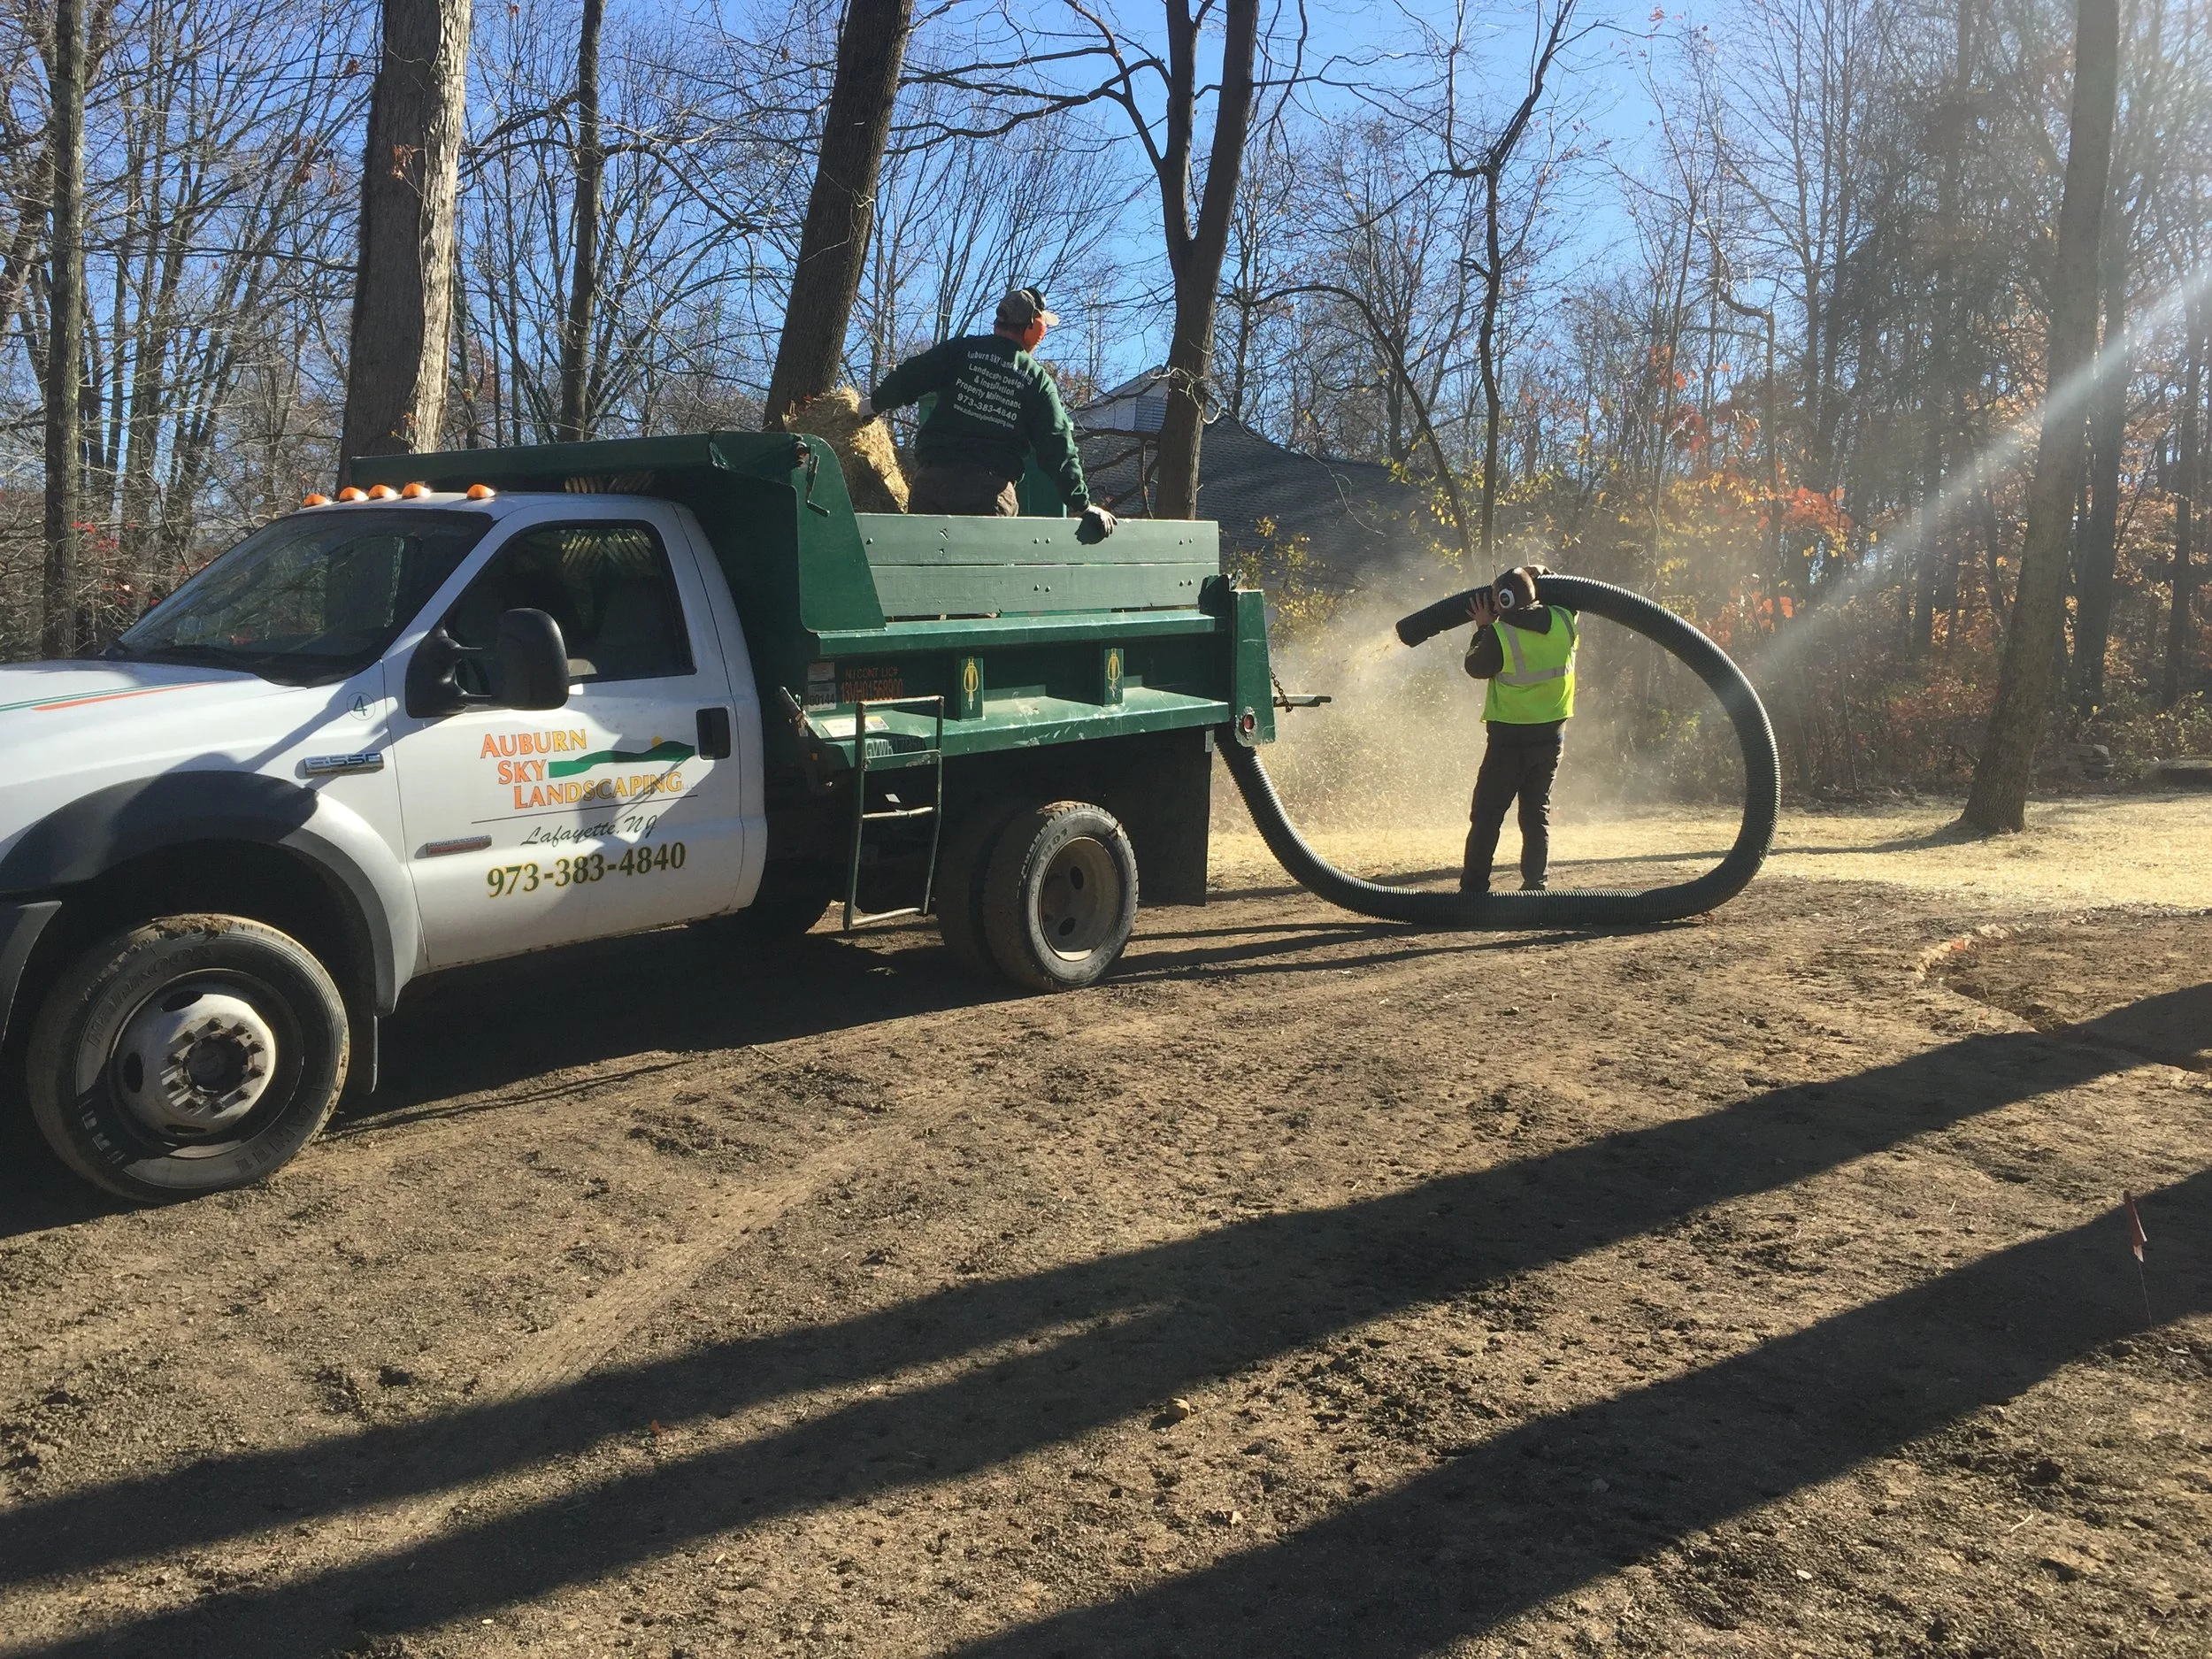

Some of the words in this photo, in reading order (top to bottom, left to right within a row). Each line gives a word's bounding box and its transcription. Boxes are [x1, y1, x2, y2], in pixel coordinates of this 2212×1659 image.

[956, 378, 986, 399] Property
[985, 391, 1022, 410] Maintenanc
[974, 375, 980, 384] &
[956, 392, 1018, 421] 973-383-4840
[353, 695, 367, 717] 4
[480, 729, 588, 759] AUBURN
[497, 759, 548, 785] SKY
[513, 771, 683, 810] LANDSCAPING
[623, 814, 658, 840] NJ
[487, 841, 687, 898] 973-383-4840
